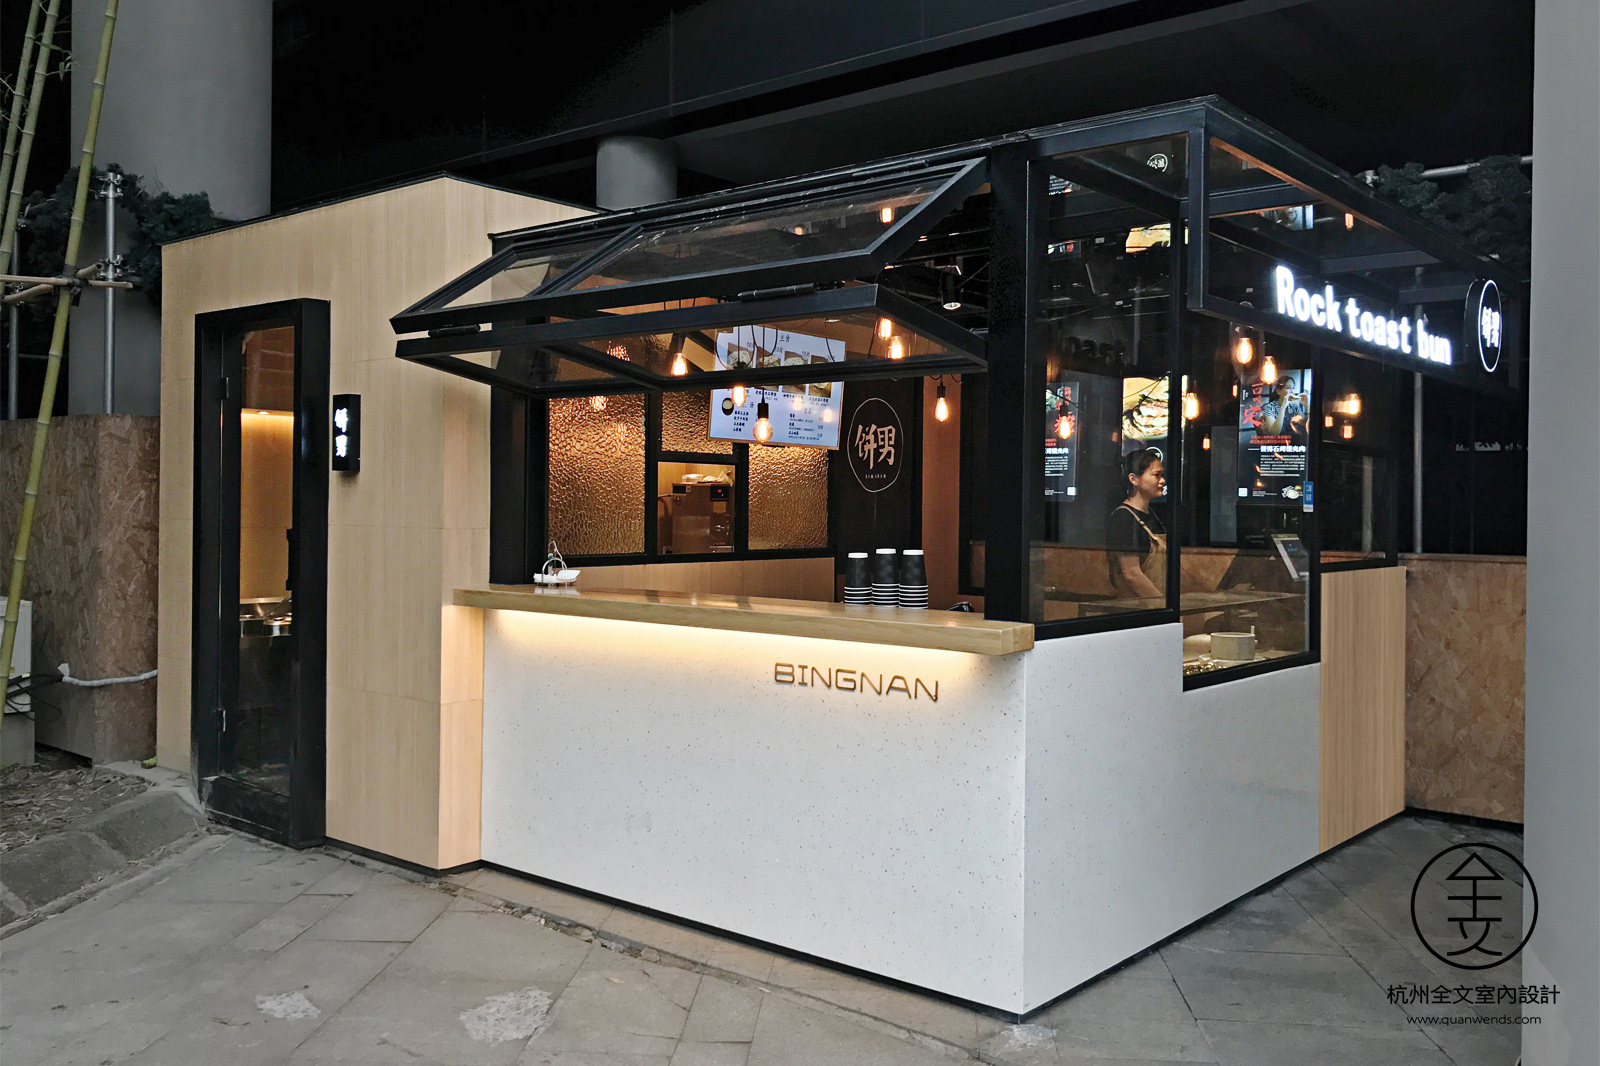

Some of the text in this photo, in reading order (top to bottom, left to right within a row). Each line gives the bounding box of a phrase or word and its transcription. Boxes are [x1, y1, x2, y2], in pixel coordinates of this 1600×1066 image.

[1275, 265, 1452, 366] Rock toast bun
[854, 423, 896, 470] 饼男
[774, 661, 939, 703] BINGNAN
